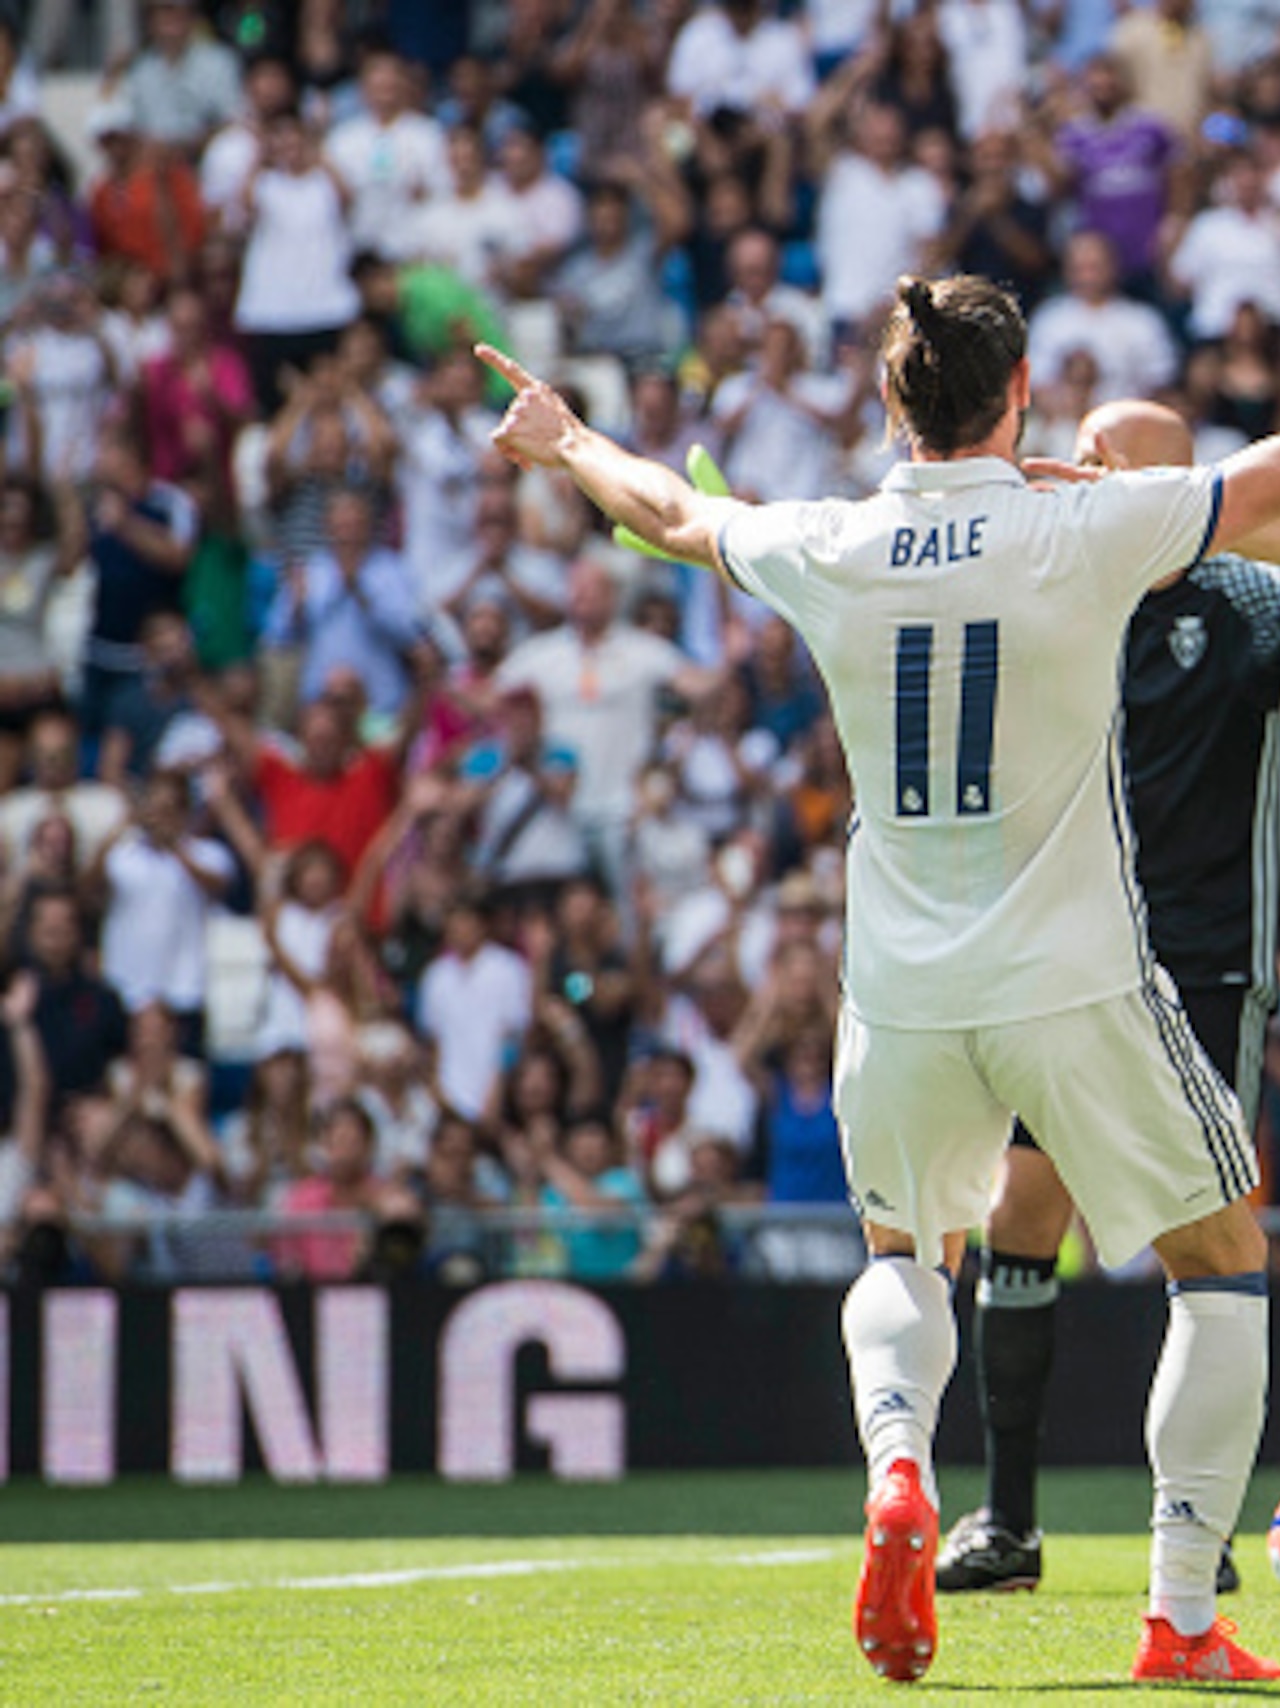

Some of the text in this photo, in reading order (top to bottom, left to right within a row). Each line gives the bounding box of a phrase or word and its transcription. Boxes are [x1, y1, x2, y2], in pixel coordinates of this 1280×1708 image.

[891, 516, 988, 568] BALE
[896, 619, 998, 817] 11
[0, 1280, 627, 1485] ING
